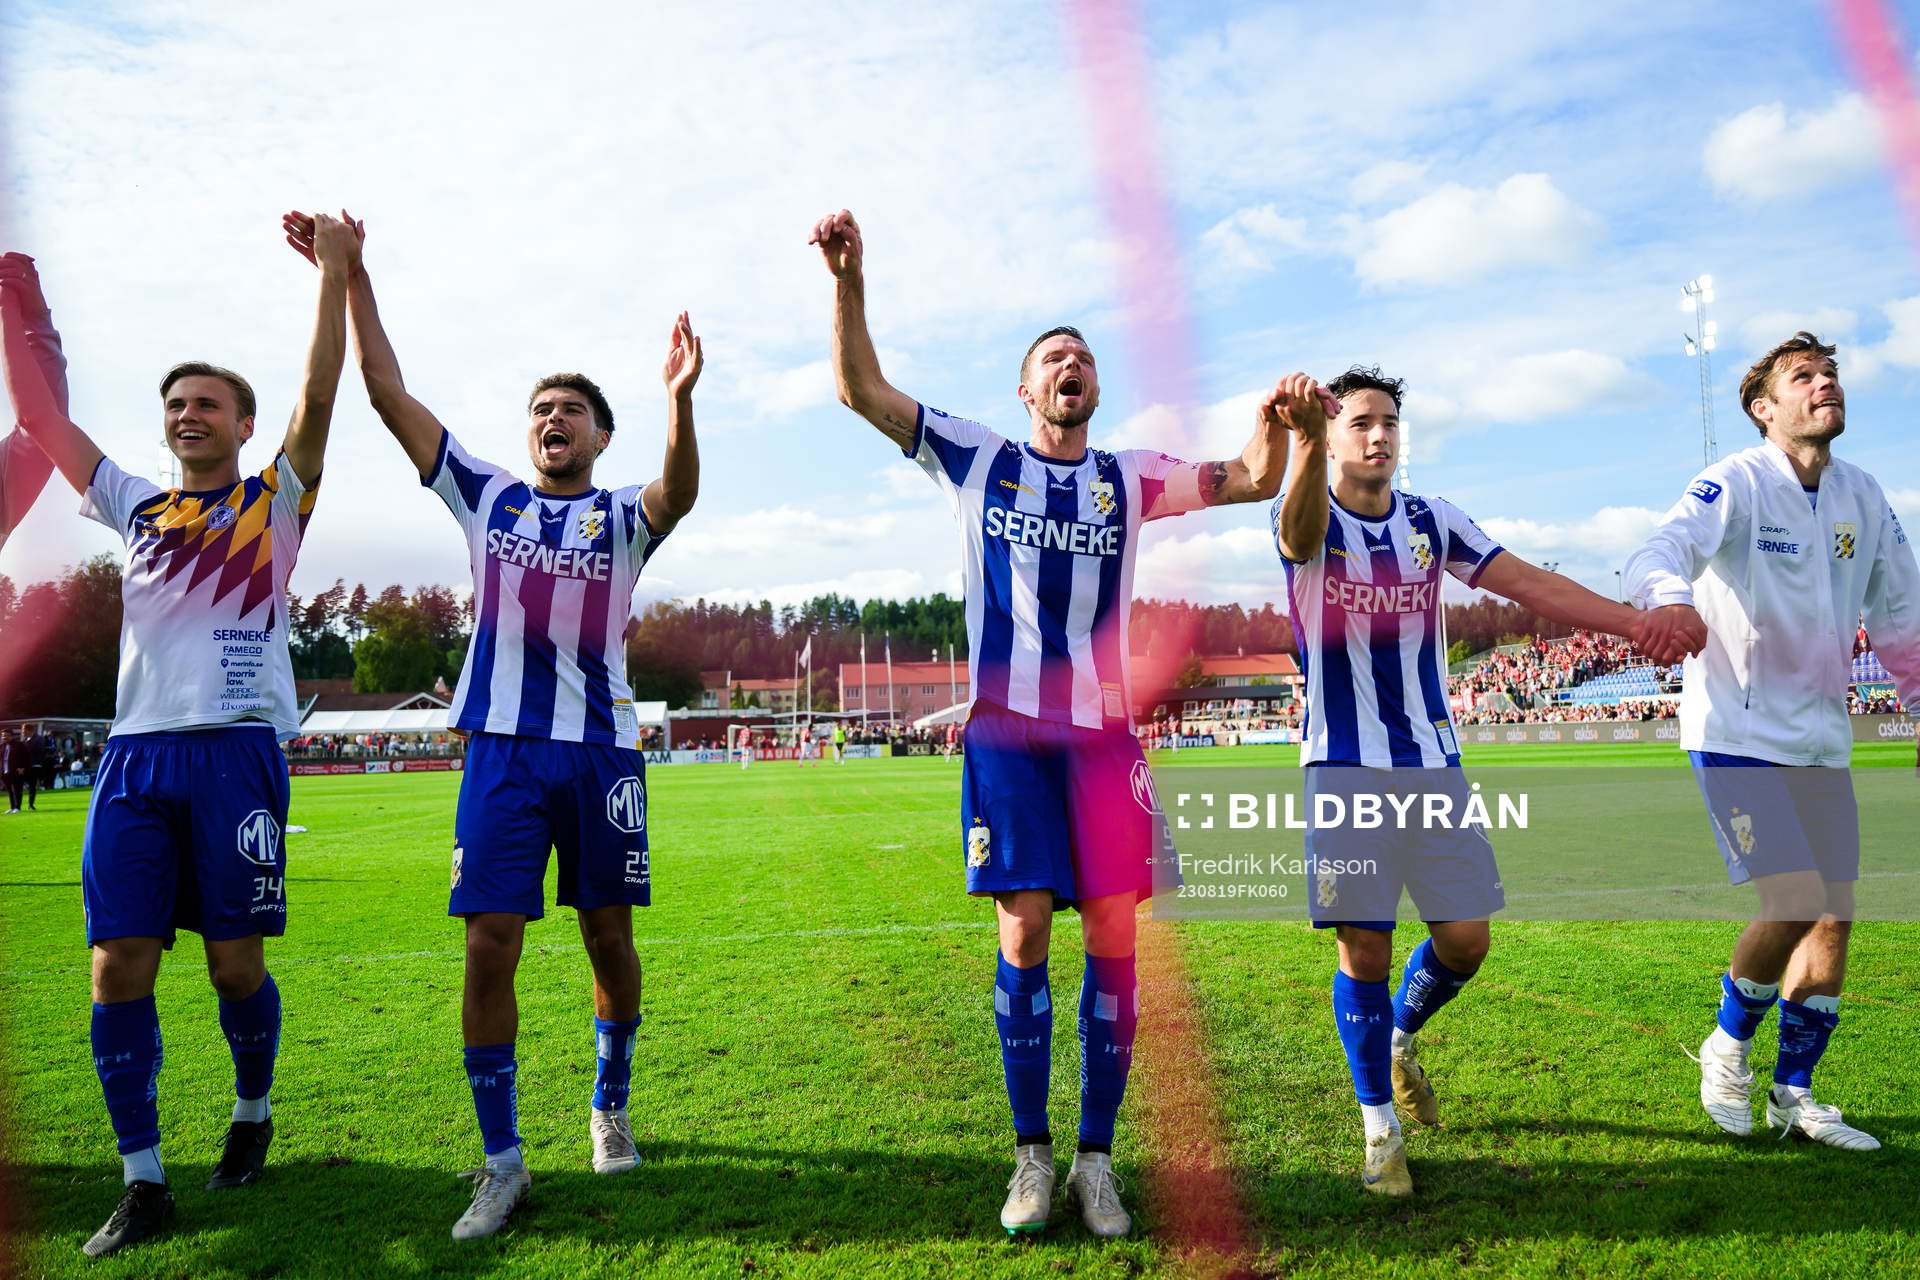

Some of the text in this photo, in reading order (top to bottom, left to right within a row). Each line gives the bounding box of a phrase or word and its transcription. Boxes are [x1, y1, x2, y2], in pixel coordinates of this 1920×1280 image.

[986, 507, 1119, 556] SERNEKE
[488, 529, 610, 581] SERNEKE
[213, 629, 271, 642] SERNEKE
[223, 645, 263, 654] FAMECO
[227, 669, 256, 677] morris
[226, 678, 244, 686] law.
[1878, 715, 1915, 737] askås
[252, 877, 283, 902] 34
[251, 904, 279, 914] CRAFT
[1006, 1036, 1041, 1048] IFK
[94, 1051, 132, 1066] IFK
[470, 1075, 497, 1089] IFK
